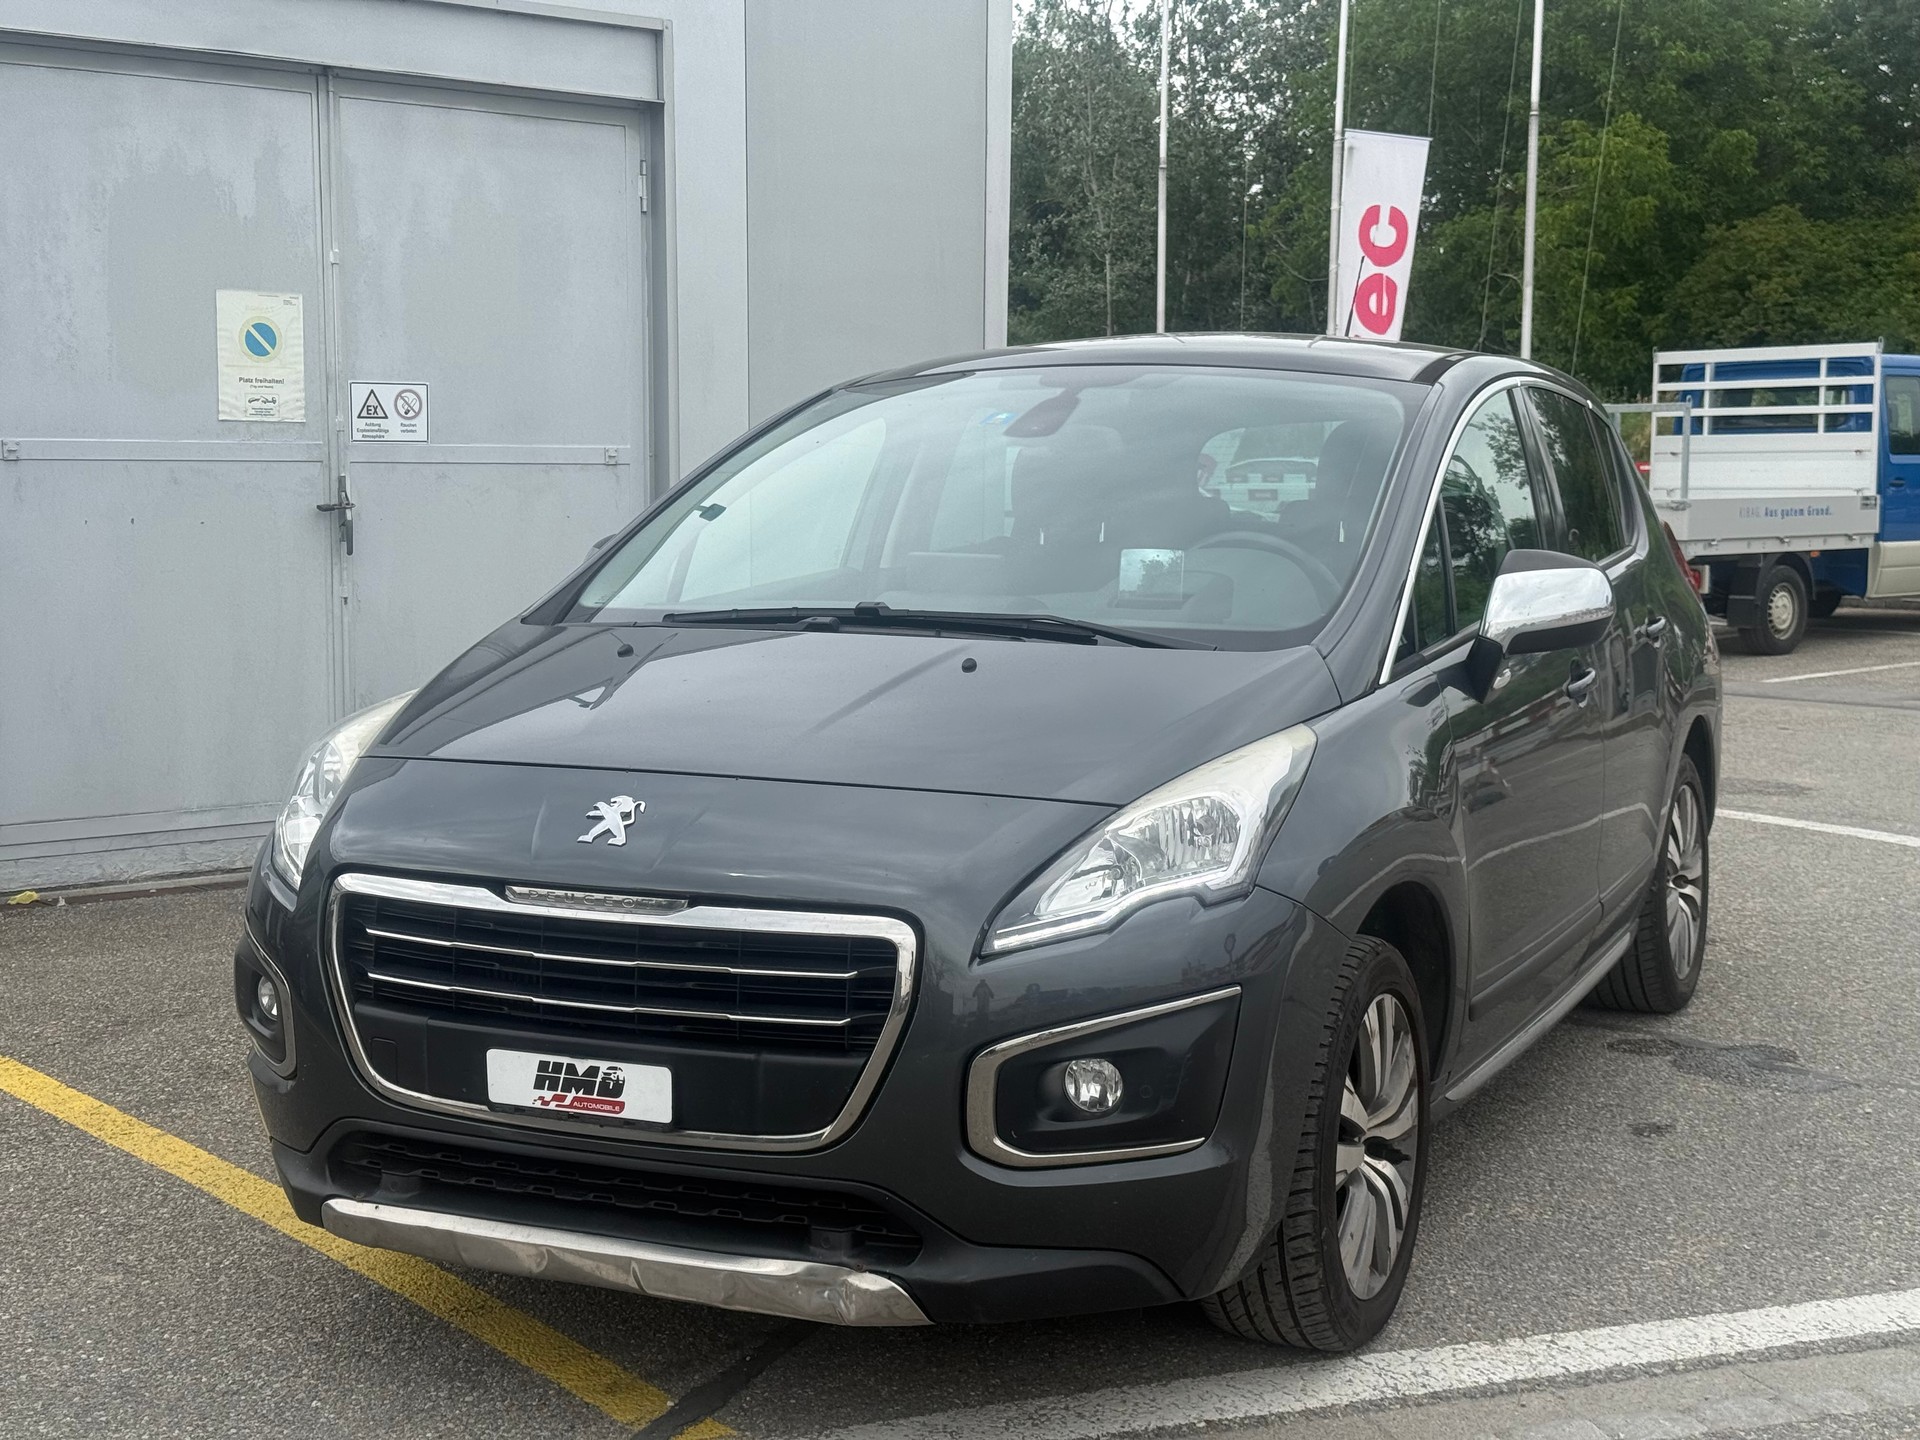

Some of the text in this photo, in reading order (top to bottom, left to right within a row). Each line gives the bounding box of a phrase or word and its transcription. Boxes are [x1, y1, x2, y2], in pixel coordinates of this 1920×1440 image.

[366, 405, 379, 416] EX
[1764, 506, 1778, 518] Aus
[1780, 507, 1805, 520] gutem
[1806, 505, 1832, 517] Grund.
[572, 1101, 620, 1113] AUTOMOBILE
